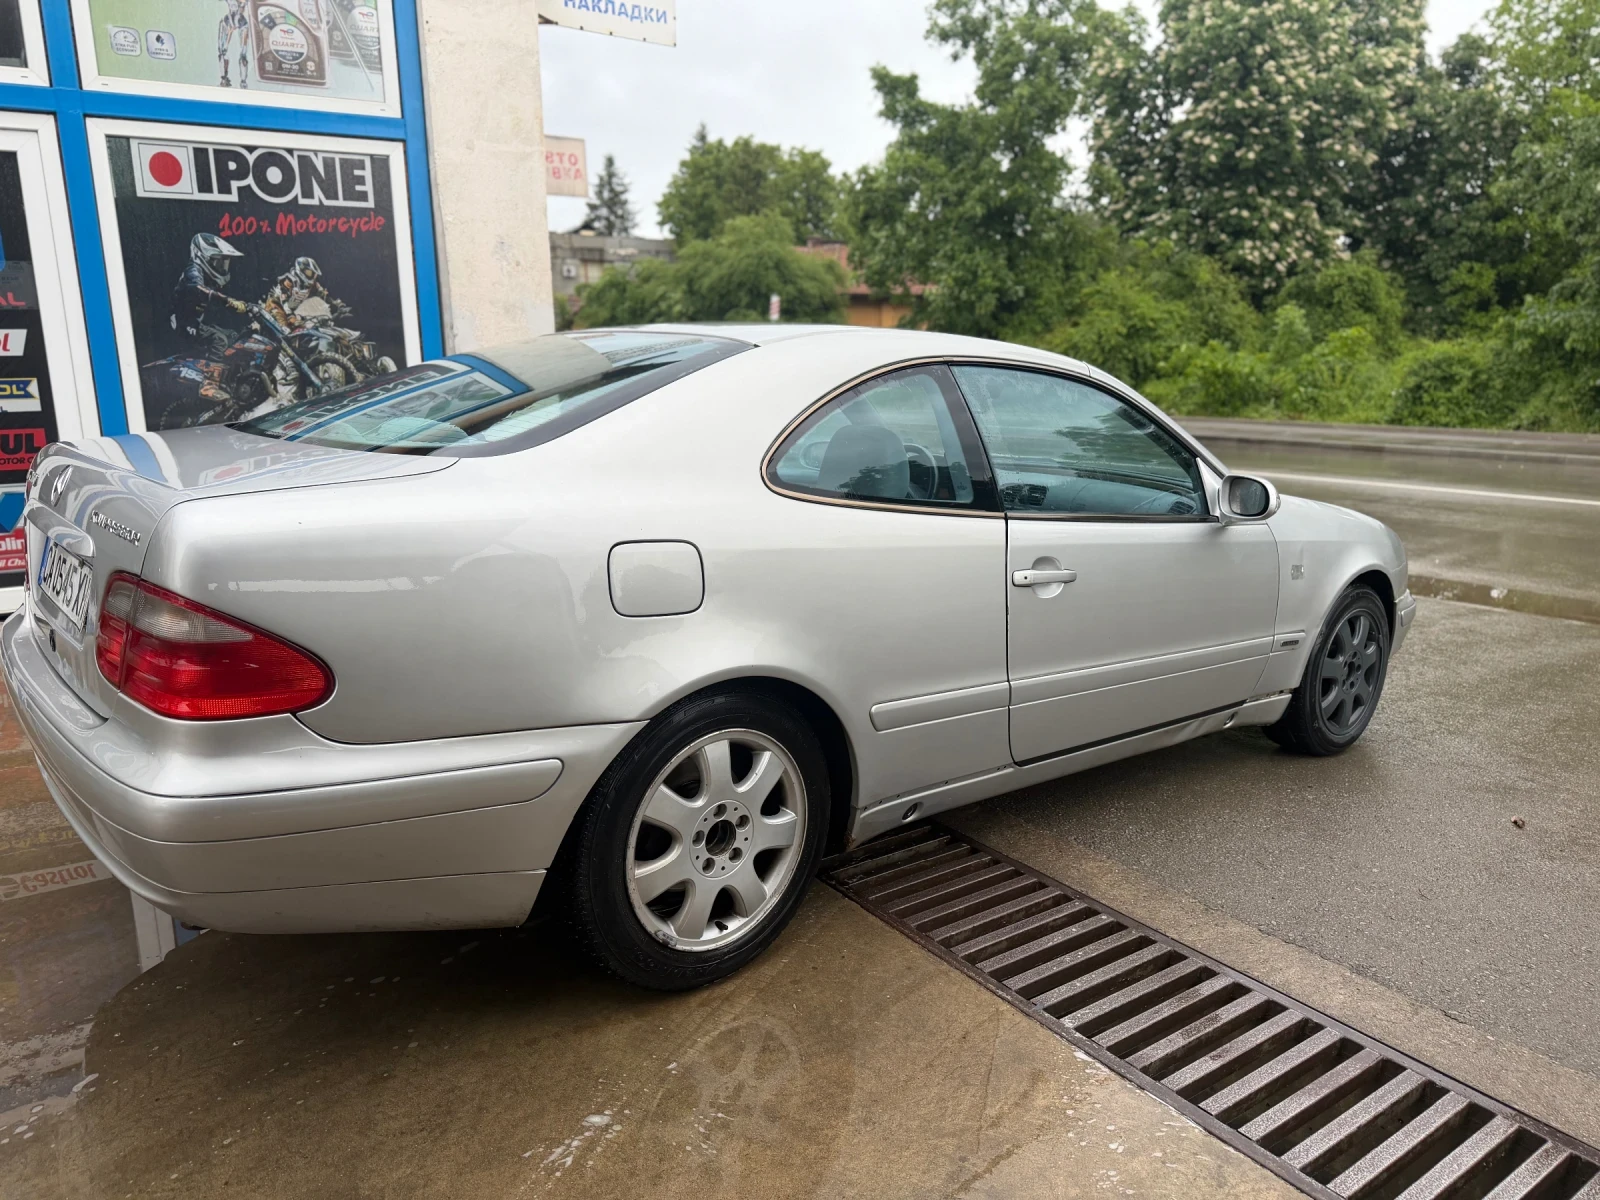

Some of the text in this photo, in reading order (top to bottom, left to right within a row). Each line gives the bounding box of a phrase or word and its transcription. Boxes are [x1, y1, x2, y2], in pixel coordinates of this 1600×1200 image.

[271, 40, 305, 48] QUARTZ
[190, 145, 372, 205] IPONE
[275, 211, 386, 238] Motorcycle
